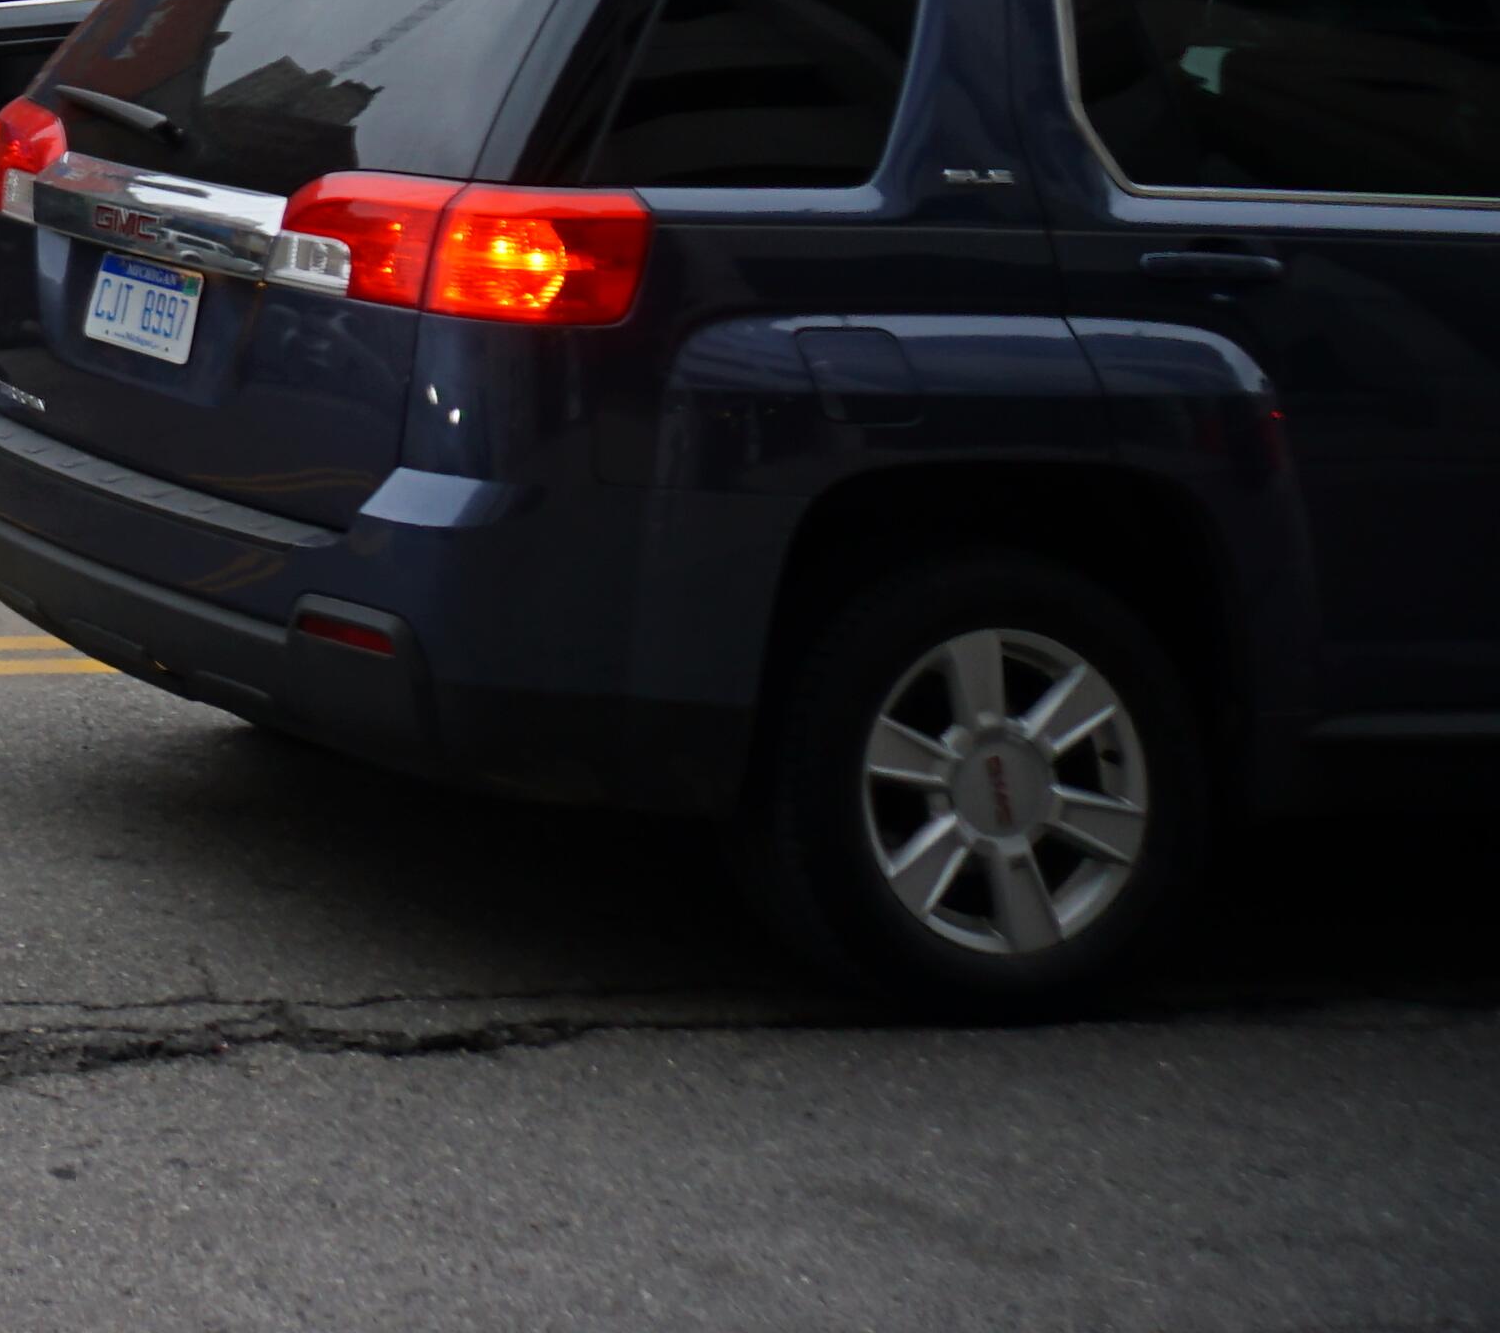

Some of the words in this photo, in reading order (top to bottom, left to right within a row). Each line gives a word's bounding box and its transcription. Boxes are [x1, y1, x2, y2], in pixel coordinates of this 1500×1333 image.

[93, 205, 160, 240] GMC
[126, 263, 177, 286] MICHIGAN
[95, 278, 135, 324] CJT
[140, 288, 190, 341] 8997
